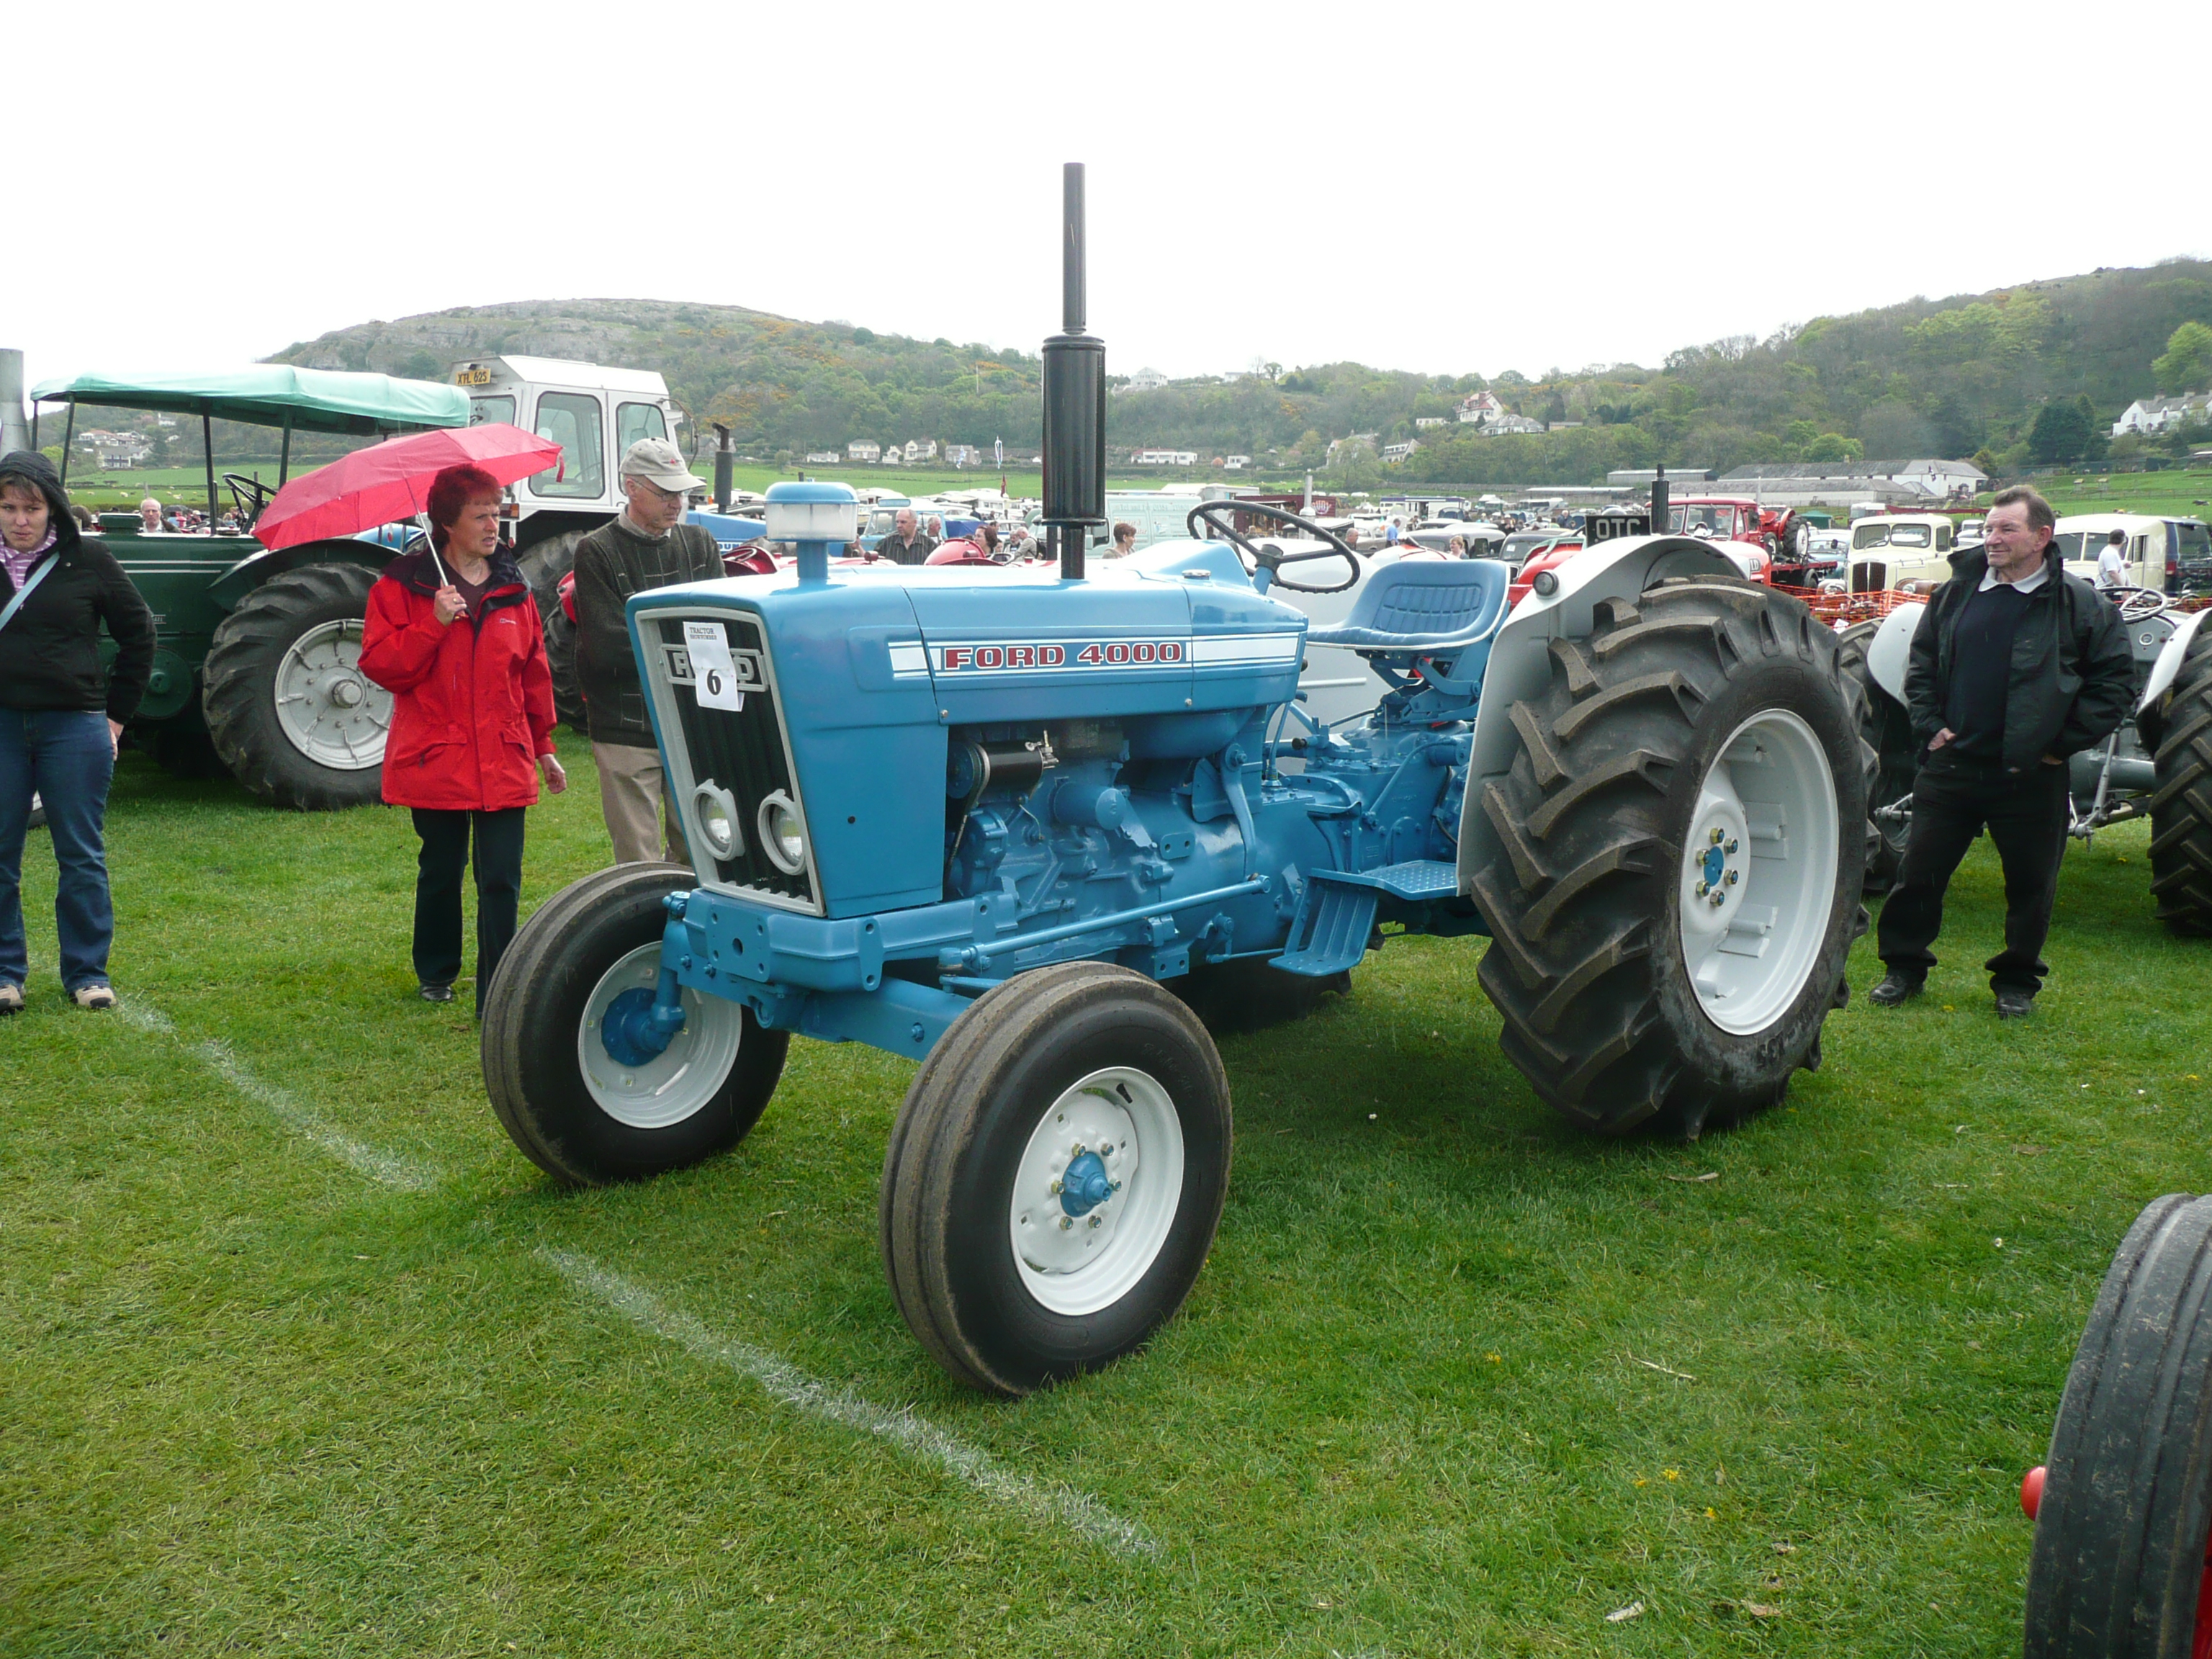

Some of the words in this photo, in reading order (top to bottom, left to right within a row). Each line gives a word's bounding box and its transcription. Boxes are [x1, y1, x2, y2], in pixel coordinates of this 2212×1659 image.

[458, 373, 471, 385] XTL
[1596, 518, 1640, 539] OTC
[945, 645, 1065, 670] FORD
[1077, 642, 1182, 665] 4000
[706, 669, 721, 696] 6
